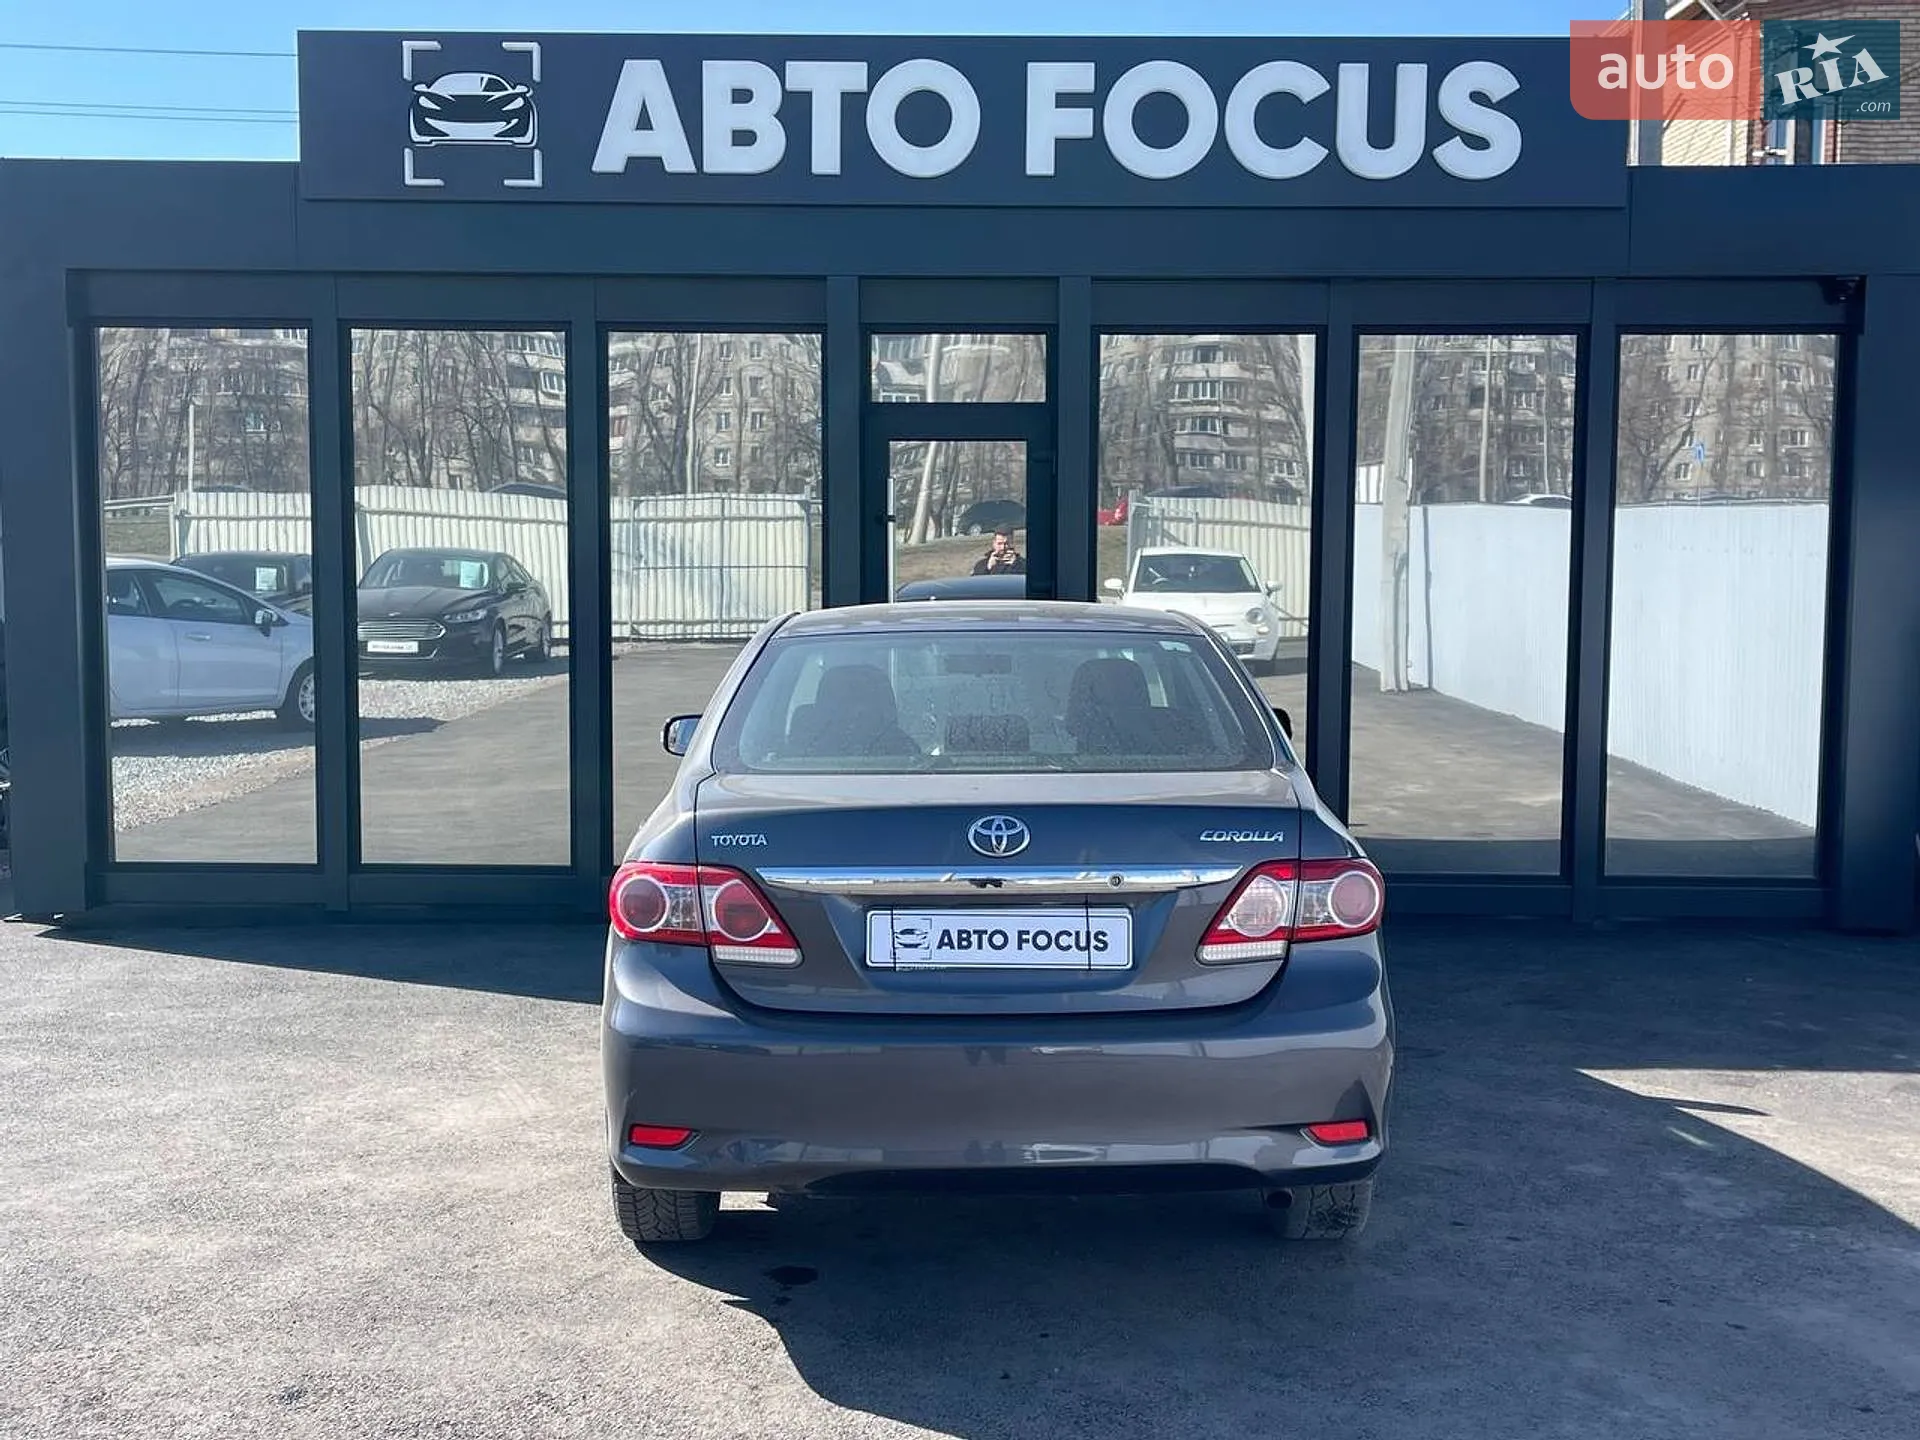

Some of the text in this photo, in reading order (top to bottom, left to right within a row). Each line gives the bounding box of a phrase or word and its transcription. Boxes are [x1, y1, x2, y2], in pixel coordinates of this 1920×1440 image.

[591, 58, 1522, 180] АВТО FOCUS
[711, 833, 768, 847] TOYOTA
[1199, 830, 1284, 843] COROLLA
[936, 929, 1109, 952] АВТО FOCUS
